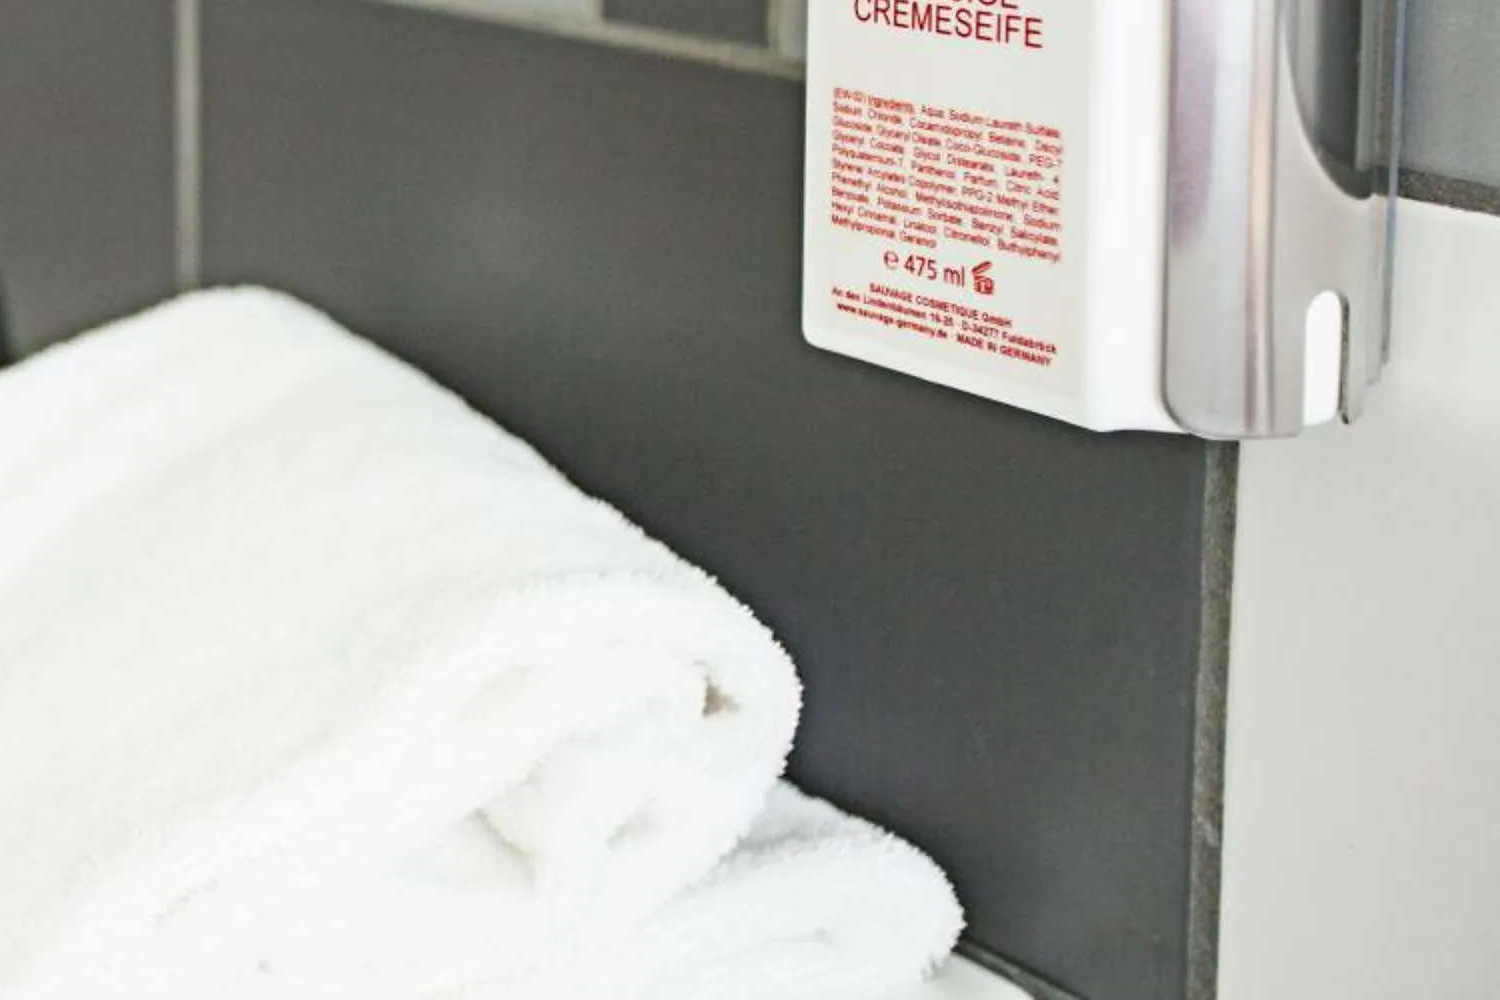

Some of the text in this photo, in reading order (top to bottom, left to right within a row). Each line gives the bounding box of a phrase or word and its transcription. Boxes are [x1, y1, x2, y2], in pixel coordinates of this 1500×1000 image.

[904, 255, 937, 280] 475
[943, 266, 965, 287] ml
[869, 281, 912, 302] SAUVAGE
[916, 293, 978, 320] COSMETIQUE
[956, 332, 982, 348] MADE
[988, 341, 996, 352] IN
[999, 344, 1051, 367] GERMANY
